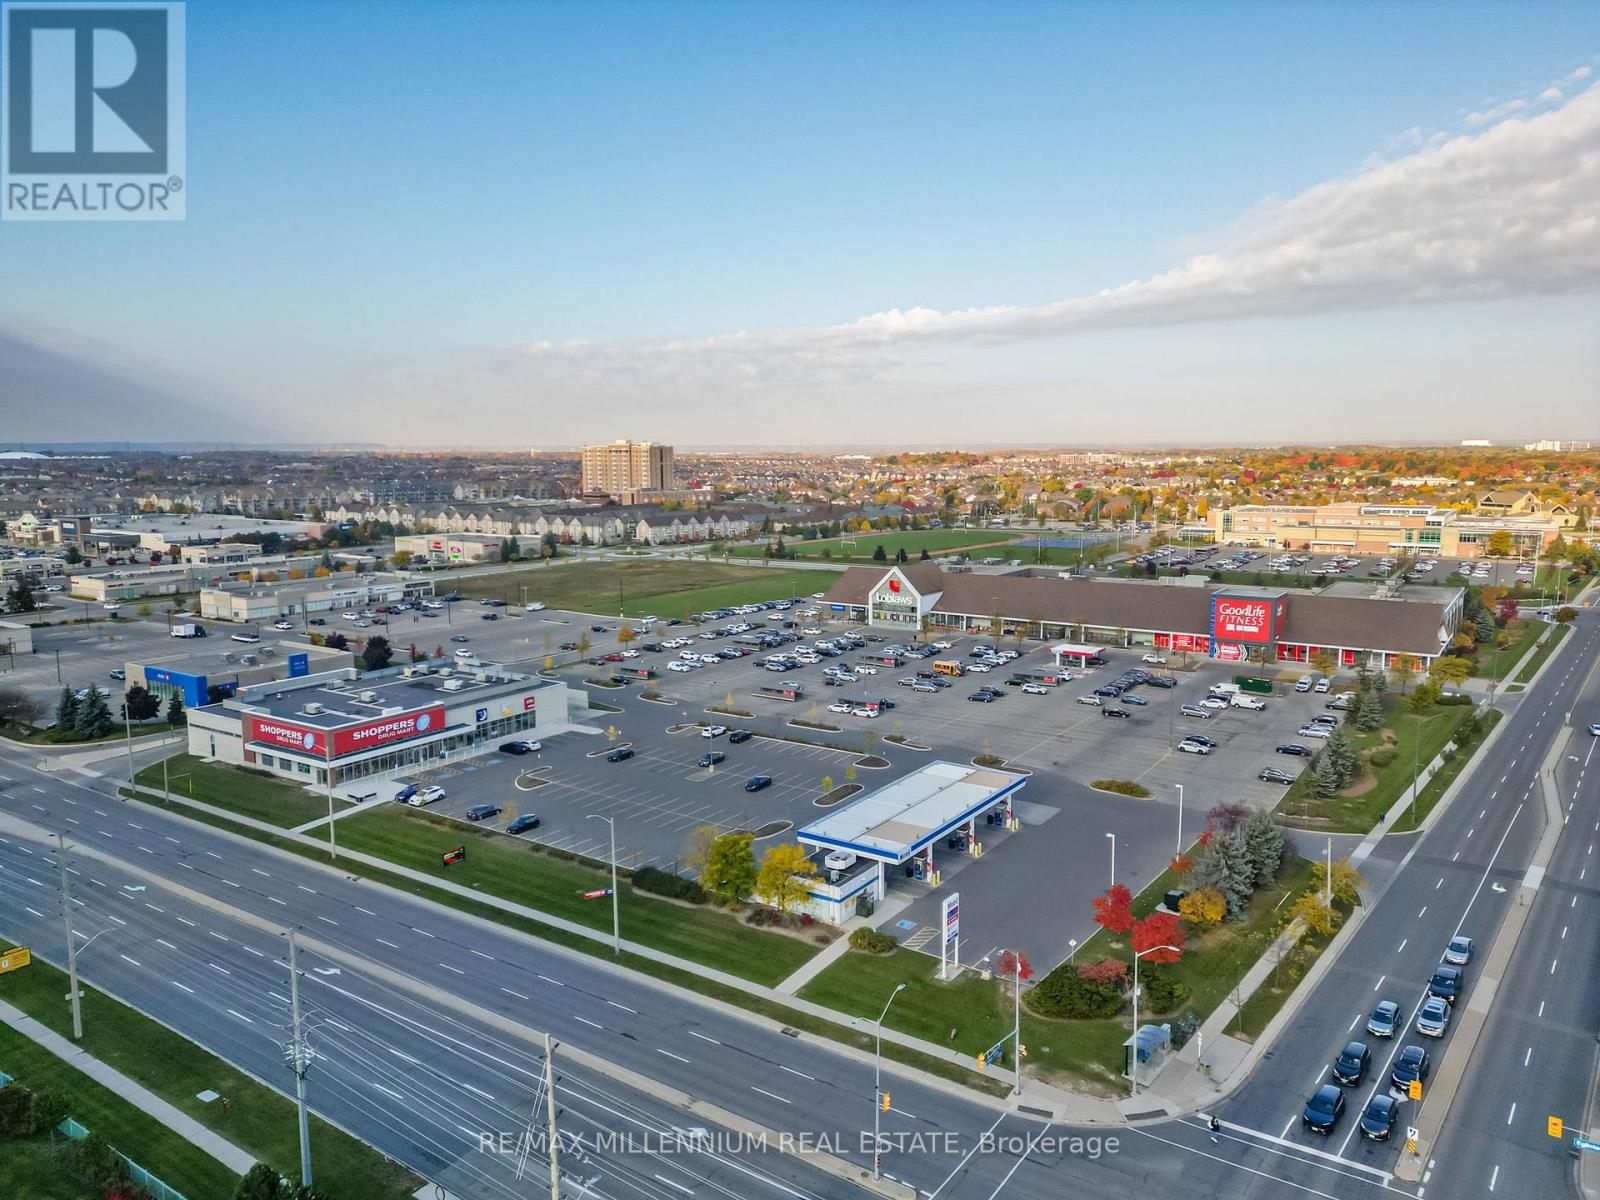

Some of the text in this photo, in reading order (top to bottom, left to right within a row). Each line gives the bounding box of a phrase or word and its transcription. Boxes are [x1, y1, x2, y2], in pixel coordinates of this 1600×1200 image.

[876, 592, 913, 605] Loblaws
[1219, 603, 1265, 617] GoodLife
[1219, 614, 1264, 626] FITNESS
[259, 724, 303, 741] SHOPPERS
[353, 718, 415, 740] SHOPPERS
[377, 726, 415, 740] DRUG MART
